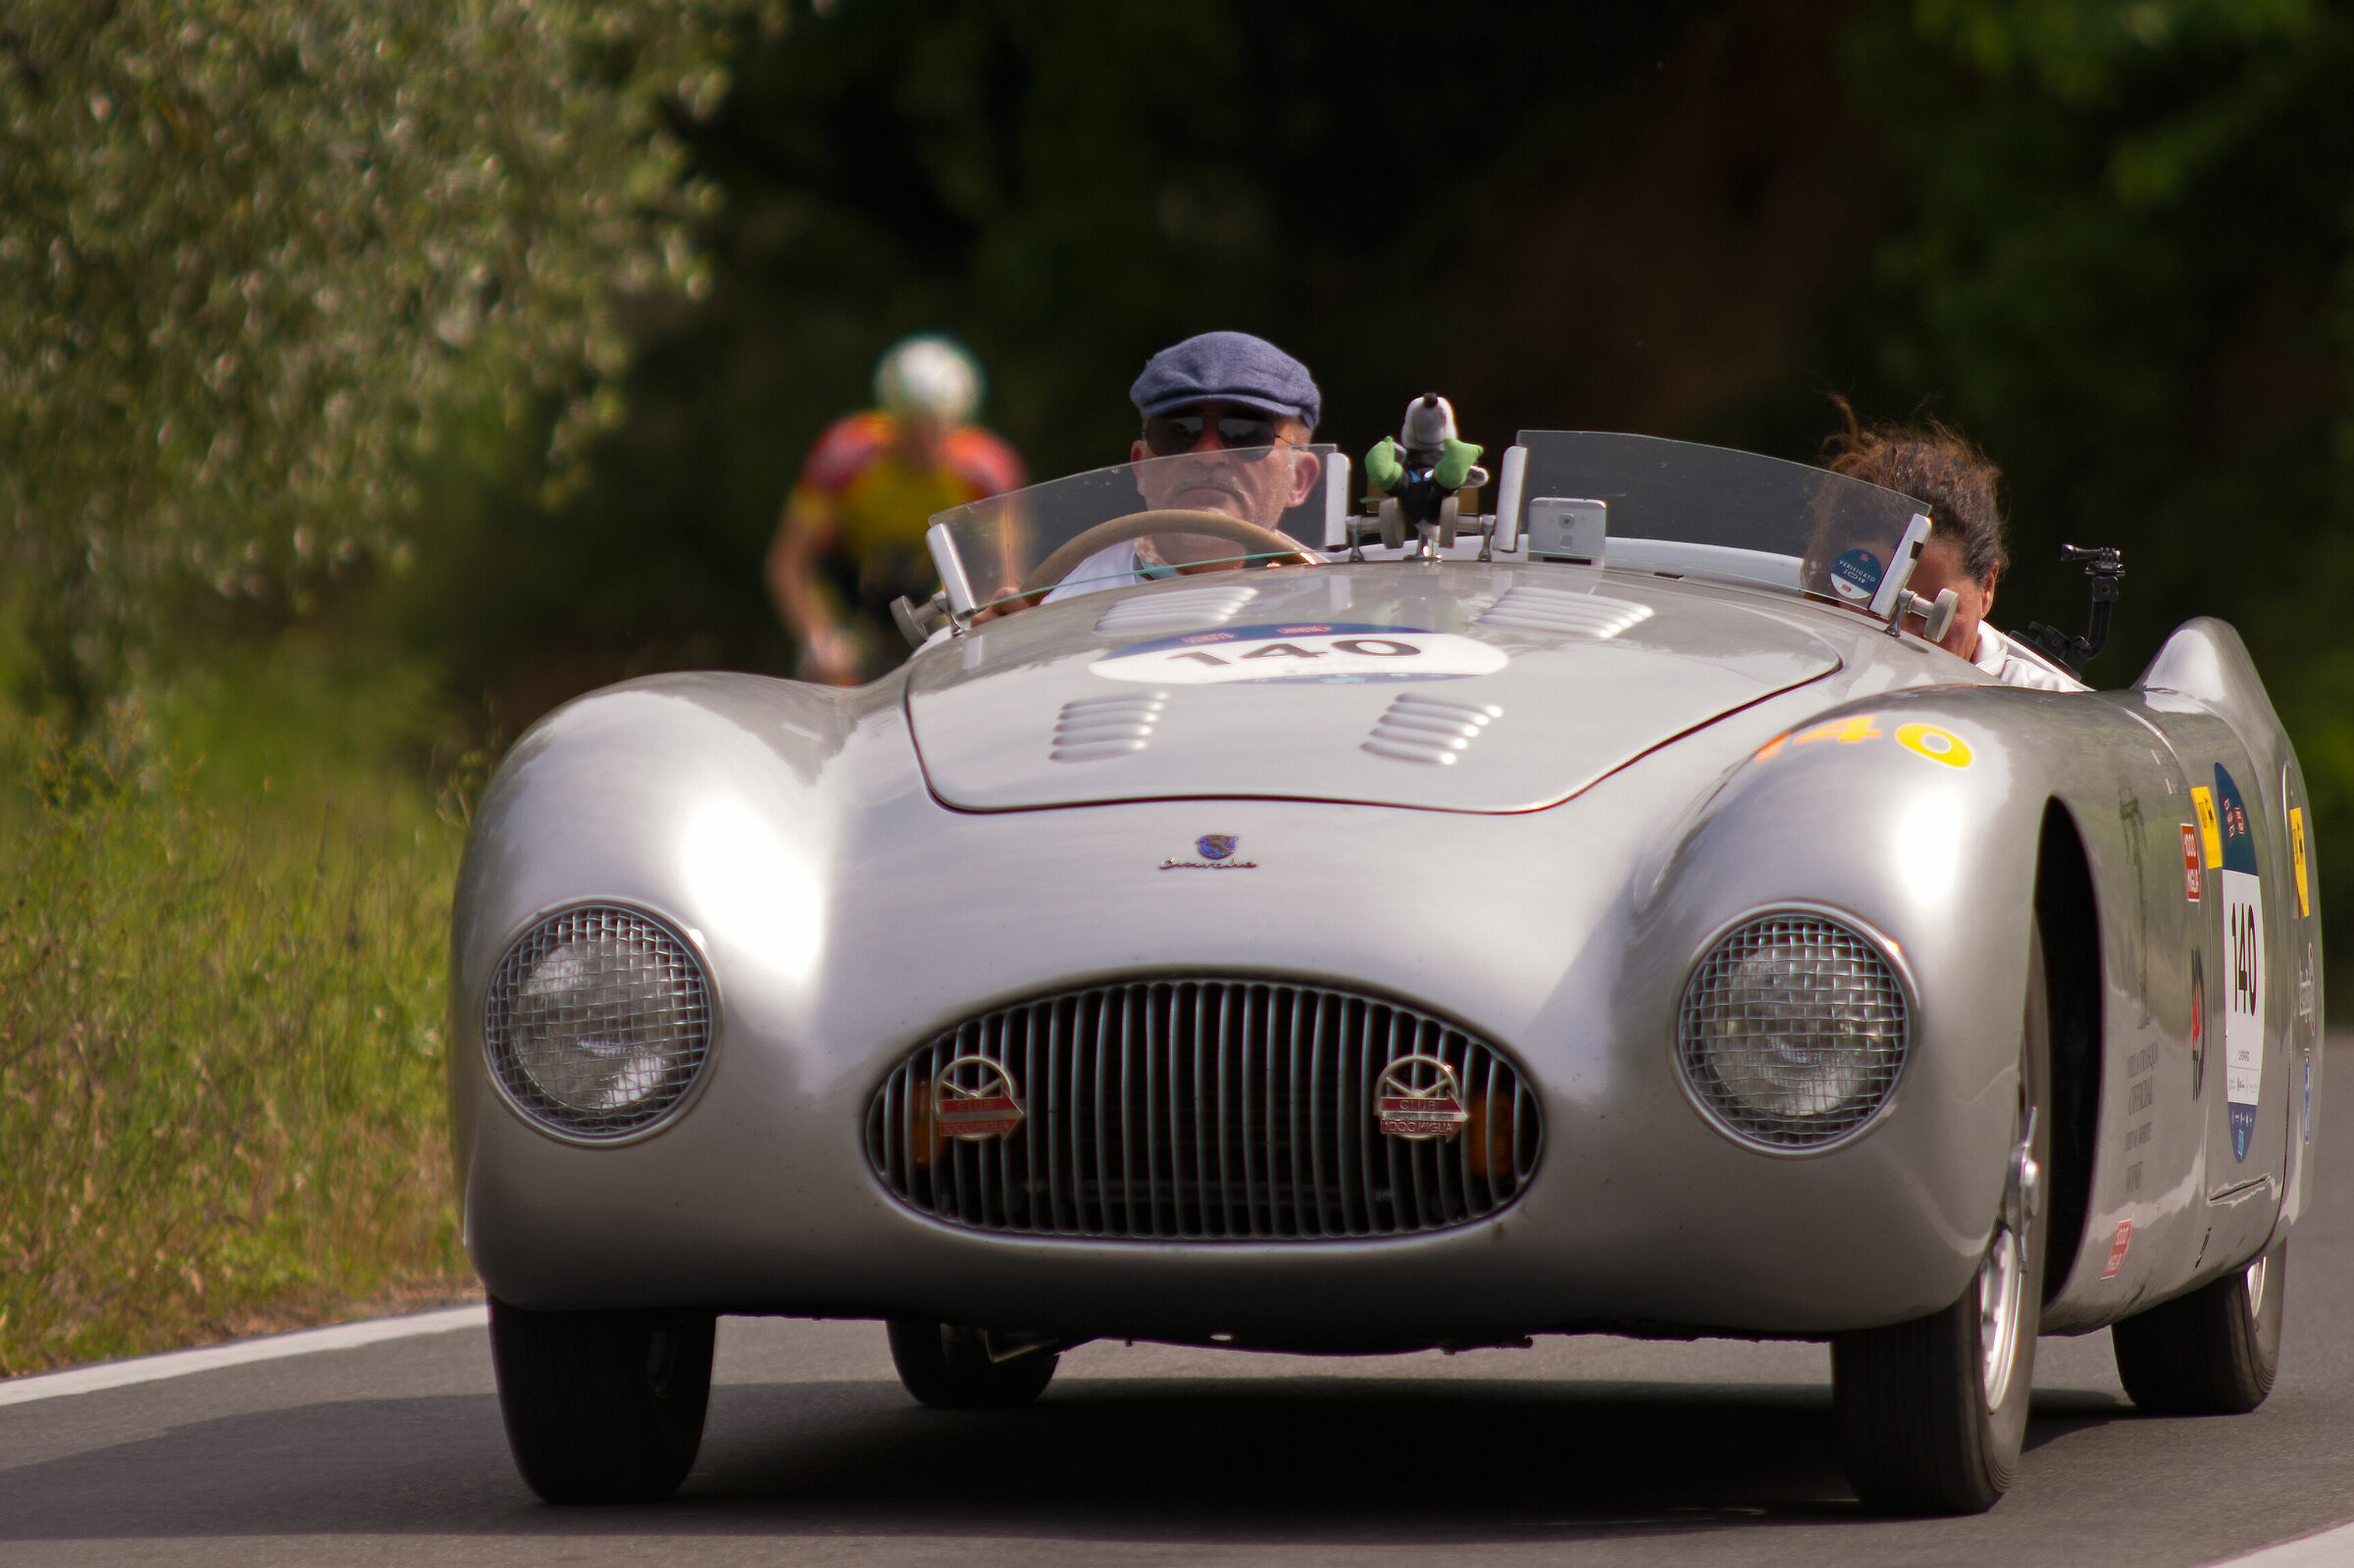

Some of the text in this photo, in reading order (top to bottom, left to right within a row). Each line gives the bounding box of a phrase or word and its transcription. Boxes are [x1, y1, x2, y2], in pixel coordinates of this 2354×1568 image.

[1839, 559, 1875, 582] VERIFICATO
[1168, 638, 1422, 667] 140
[2230, 901, 2258, 1017] 140
